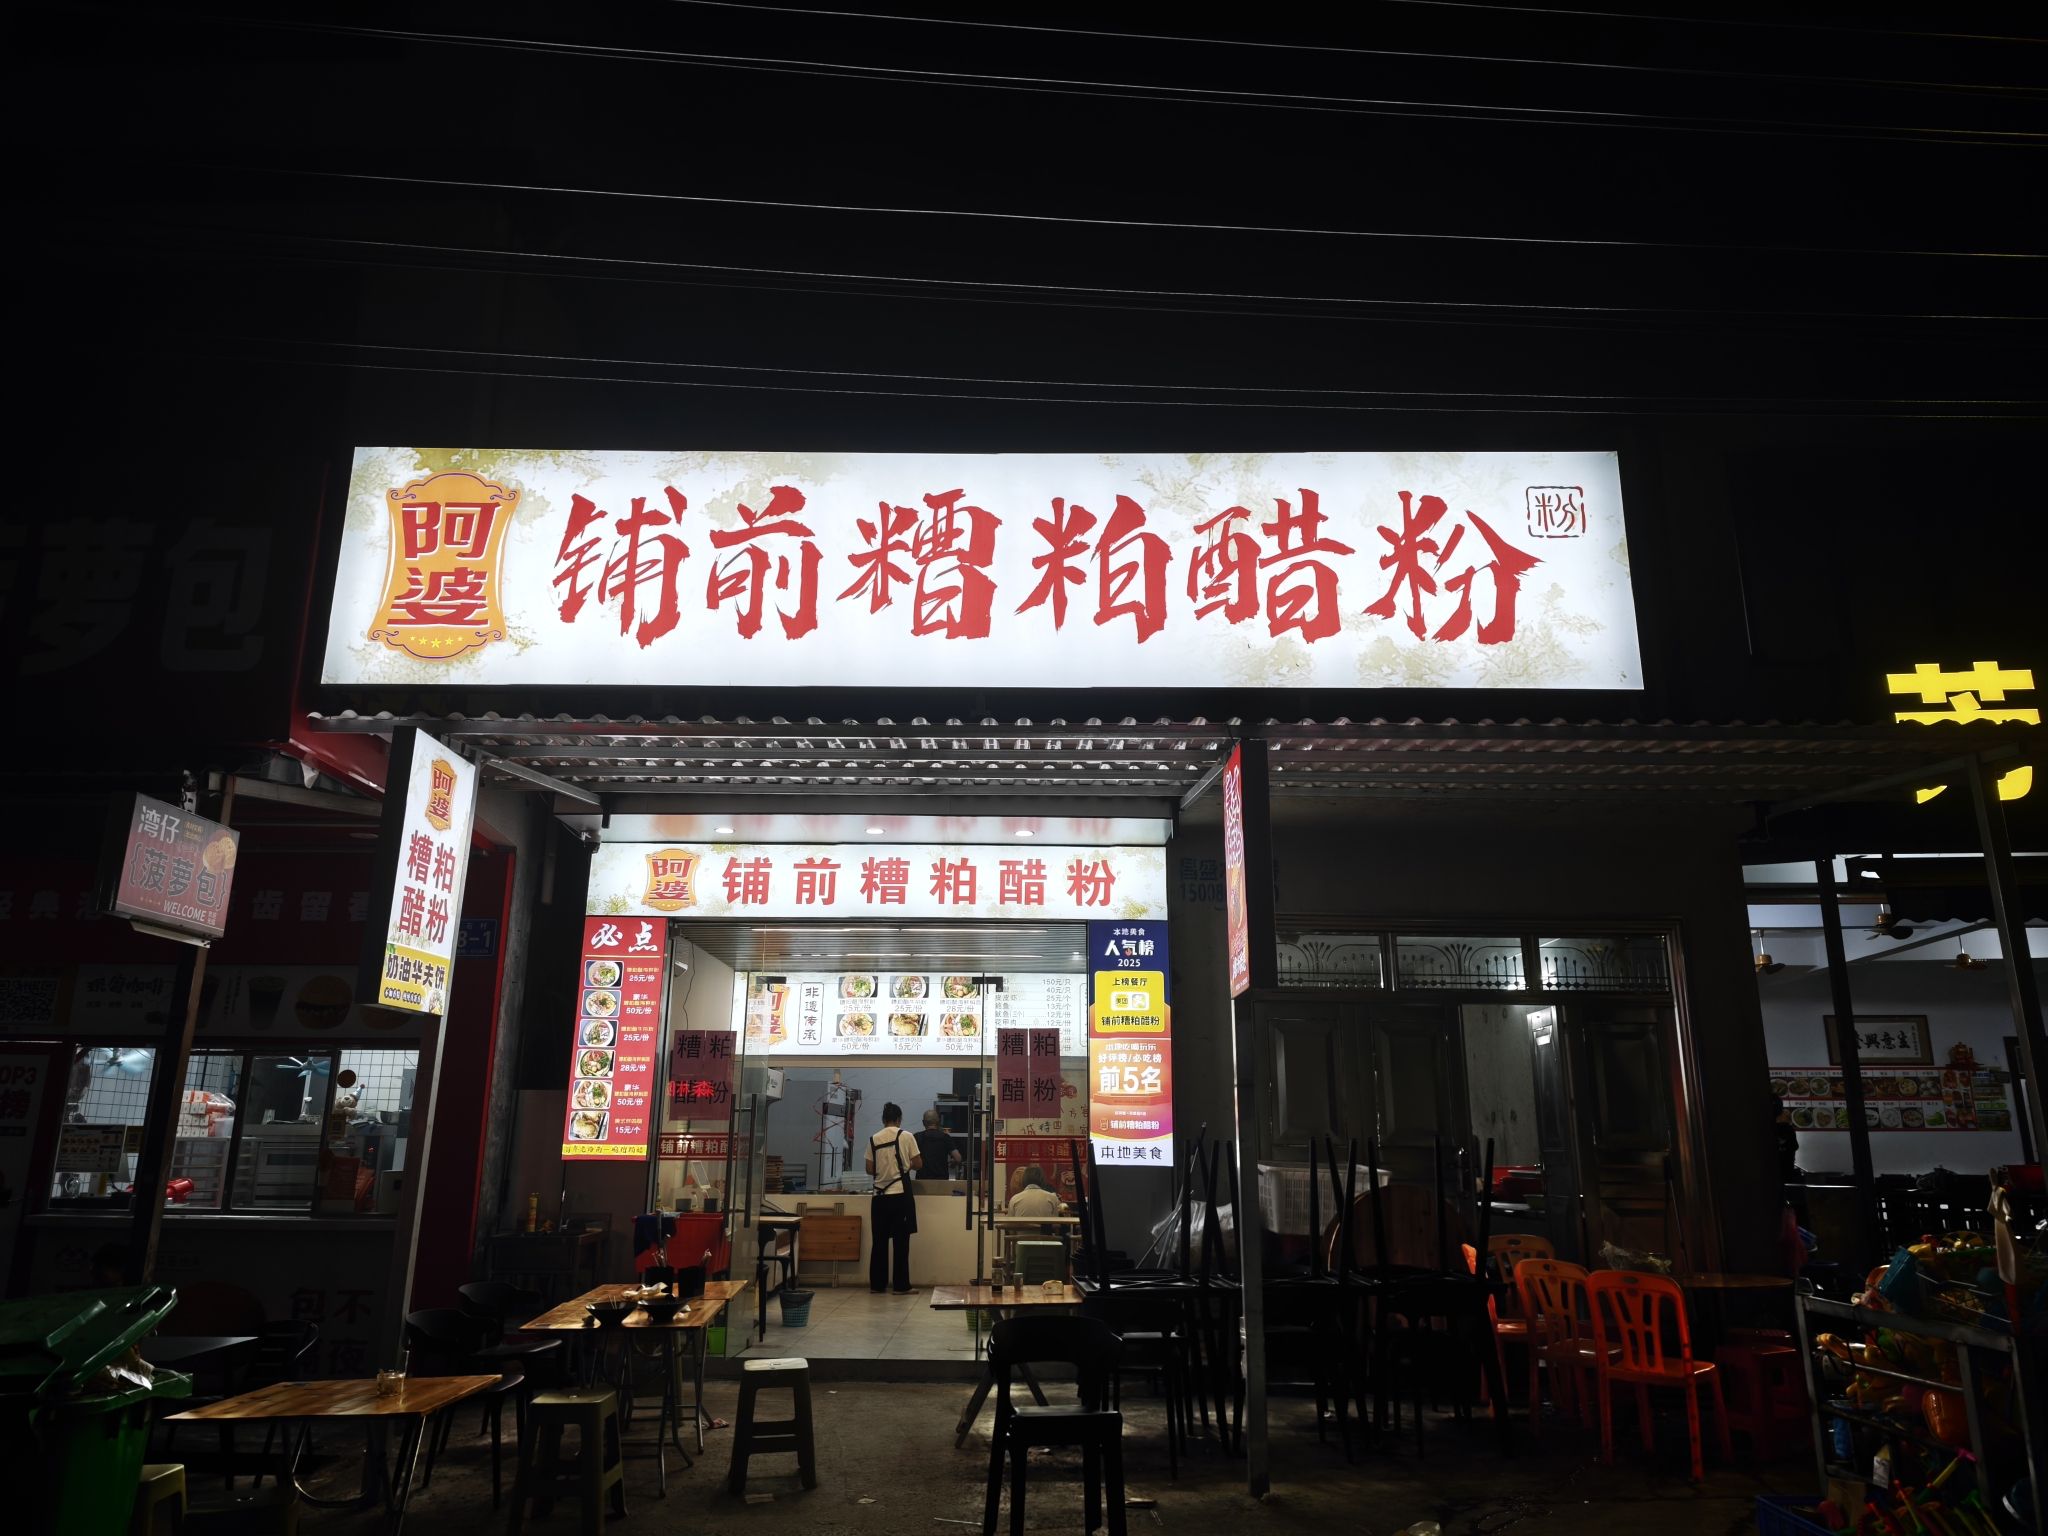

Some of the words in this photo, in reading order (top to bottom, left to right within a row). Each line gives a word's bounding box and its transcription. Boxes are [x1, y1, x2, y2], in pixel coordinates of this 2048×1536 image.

[1534, 492, 1578, 533] 粉
[386, 499, 503, 628] 阿婆
[552, 485, 1544, 649] 铺前糟粕醋粉
[429, 768, 453, 823] 阿婆
[138, 805, 182, 844] 湾仔
[648, 858, 693, 901] 阿婆
[721, 857, 1118, 905] 铺前糟粕醋粉
[163, 900, 207, 922] WELCOME
[591, 921, 658, 952] 必点
[1113, 928, 1145, 936] 本地美食
[1104, 939, 1154, 956] 人气榜
[386, 954, 446, 990] 奶油华夫饼
[1117, 958, 1141, 967] 2025
[1112, 977, 1148, 986] 上榜餐厅
[802, 986, 819, 1040] 非遗传承
[1102, 1016, 1160, 1026] 铺前糟粕醋粉
[1002, 1032, 1057, 1057] 糟粕
[1002, 1077, 1057, 1103] 醋粉
[1098, 1065, 1162, 1093] 前5名
[1101, 1145, 1163, 1160] 本地美食
